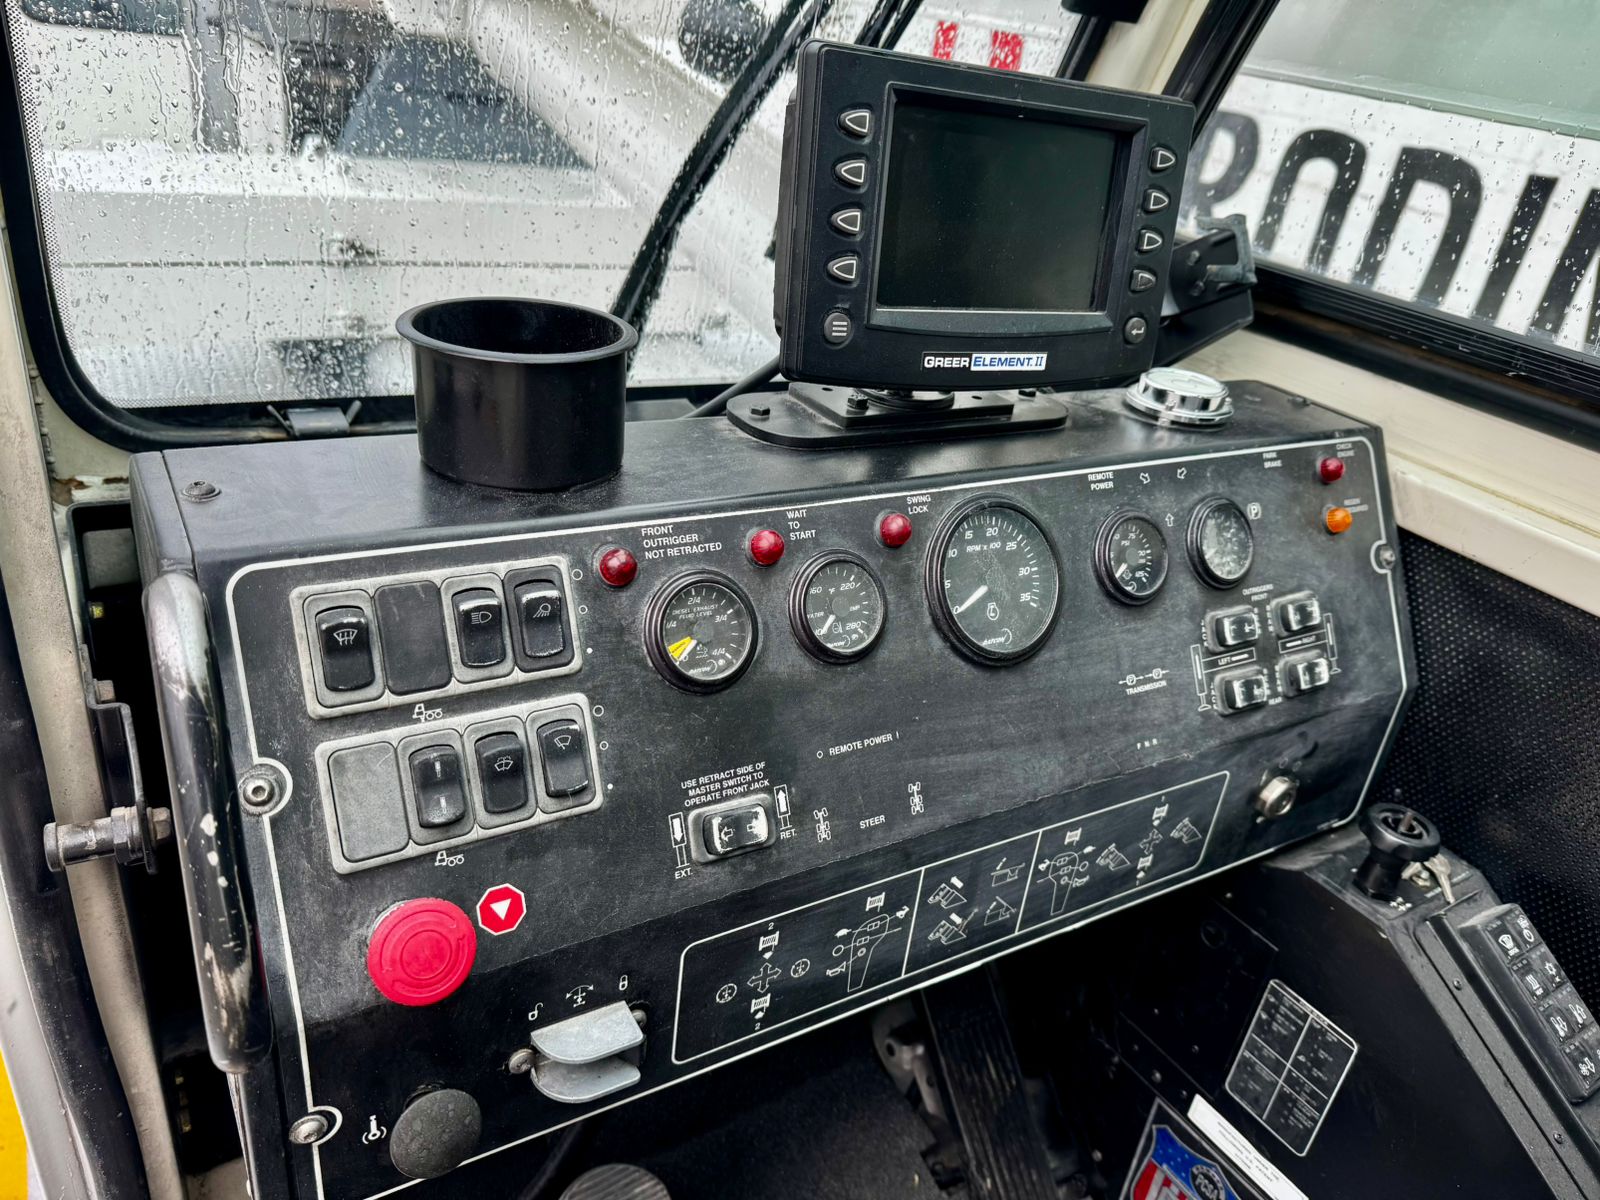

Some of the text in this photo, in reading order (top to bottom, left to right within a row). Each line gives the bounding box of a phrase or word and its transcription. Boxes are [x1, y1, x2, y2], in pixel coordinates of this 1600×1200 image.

[924, 356, 969, 368] GREER
[1088, 471, 1114, 481] REMOTE
[1090, 481, 1114, 491] POWER
[906, 494, 931, 504] SWING
[786, 509, 807, 519] WAIT
[908, 505, 929, 514] LOCK
[788, 520, 800, 530] TO
[641, 525, 674, 536] FRONT
[790, 530, 816, 541] START
[965, 530, 973, 539] 15
[986, 527, 998, 536] 20
[643, 533, 699, 548] OUTRIGGER
[645, 542, 722, 560] NOT RETRACTED
[966, 544, 981, 552] RPM
[1005, 541, 1017, 551] 25
[1018, 566, 1030, 576] 30
[840, 582, 855, 590] 220
[688, 596, 701, 604] 2/4
[1020, 592, 1031, 602] 35
[714, 614, 728, 622] 3/4
[846, 621, 861, 630] 280
[712, 647, 726, 655] 4/4
[1218, 656, 1231, 666] LEFT
[1126, 680, 1167, 695] TRANSMISSION
[829, 733, 893, 756] REMOTE POWER
[681, 761, 766, 789] USE RETRACT SIDE OF
[688, 771, 764, 797] MASTER SWITCH TO
[684, 779, 770, 807] OPERATE FRONT JACK
[859, 814, 886, 829] STEER
[780, 829, 797, 840] RET.
[674, 867, 693, 880] EXT.
[768, 922, 774, 930] 2
